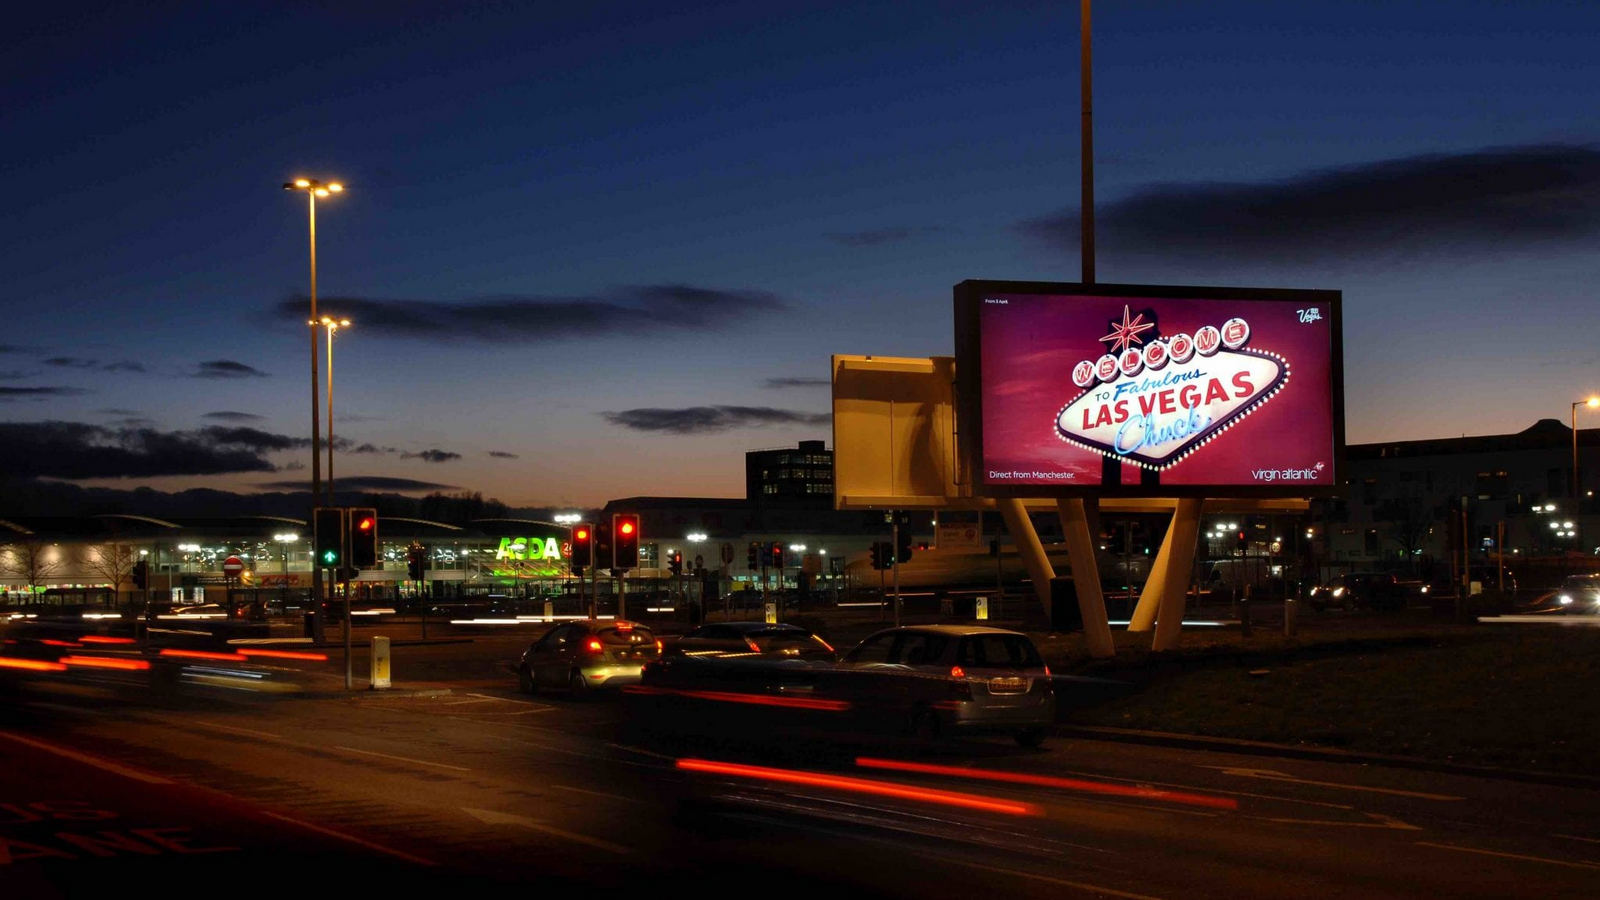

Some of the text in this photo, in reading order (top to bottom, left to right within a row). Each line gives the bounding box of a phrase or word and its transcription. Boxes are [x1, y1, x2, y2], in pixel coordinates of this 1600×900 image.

[1075, 322, 1247, 384] WELCOME
[1082, 371, 1255, 430] LAS VEGAS
[1095, 368, 1208, 402] TO Fabulous
[1114, 403, 1212, 455] Chuck
[989, 470, 1075, 479] Direct from Manchester.
[1251, 468, 1318, 482] virgin atlantic
[495, 537, 561, 560] ASDA
